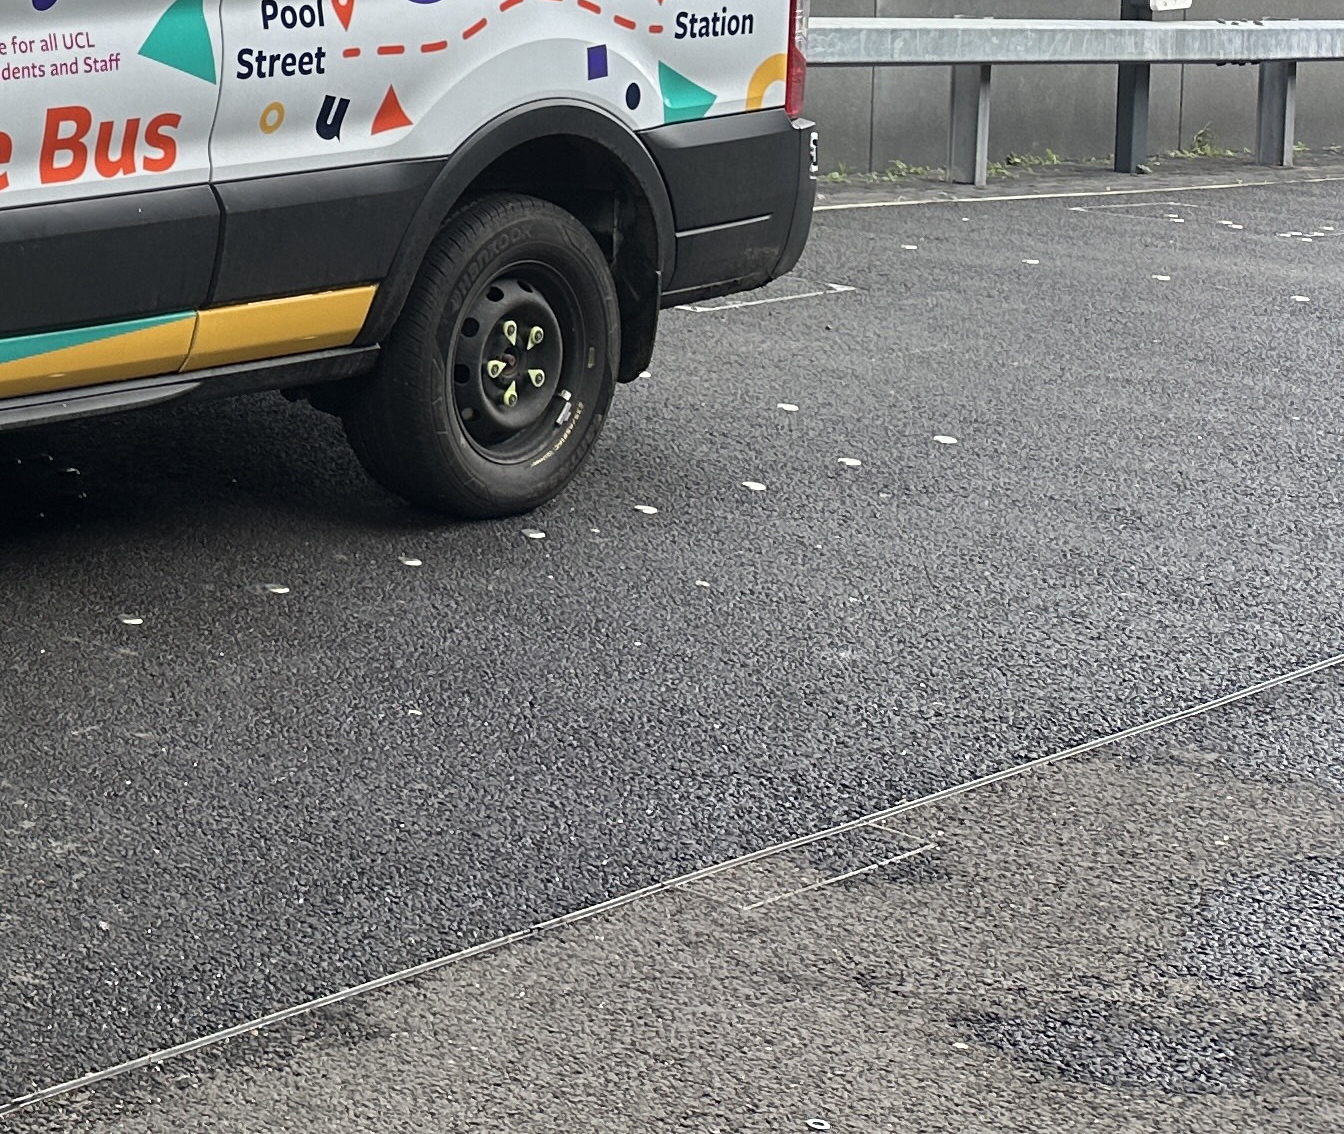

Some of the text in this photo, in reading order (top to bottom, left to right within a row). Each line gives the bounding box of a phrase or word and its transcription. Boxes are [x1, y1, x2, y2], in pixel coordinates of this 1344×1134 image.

[673, 7, 755, 39] Station
[10, 36, 36, 55] for
[40, 33, 58, 53] all
[62, 32, 96, 51] UCL
[50, 57, 79, 77] and
[83, 52, 122, 74] Staff
[235, 46, 327, 80] Street
[38, 105, 182, 186] Bus
